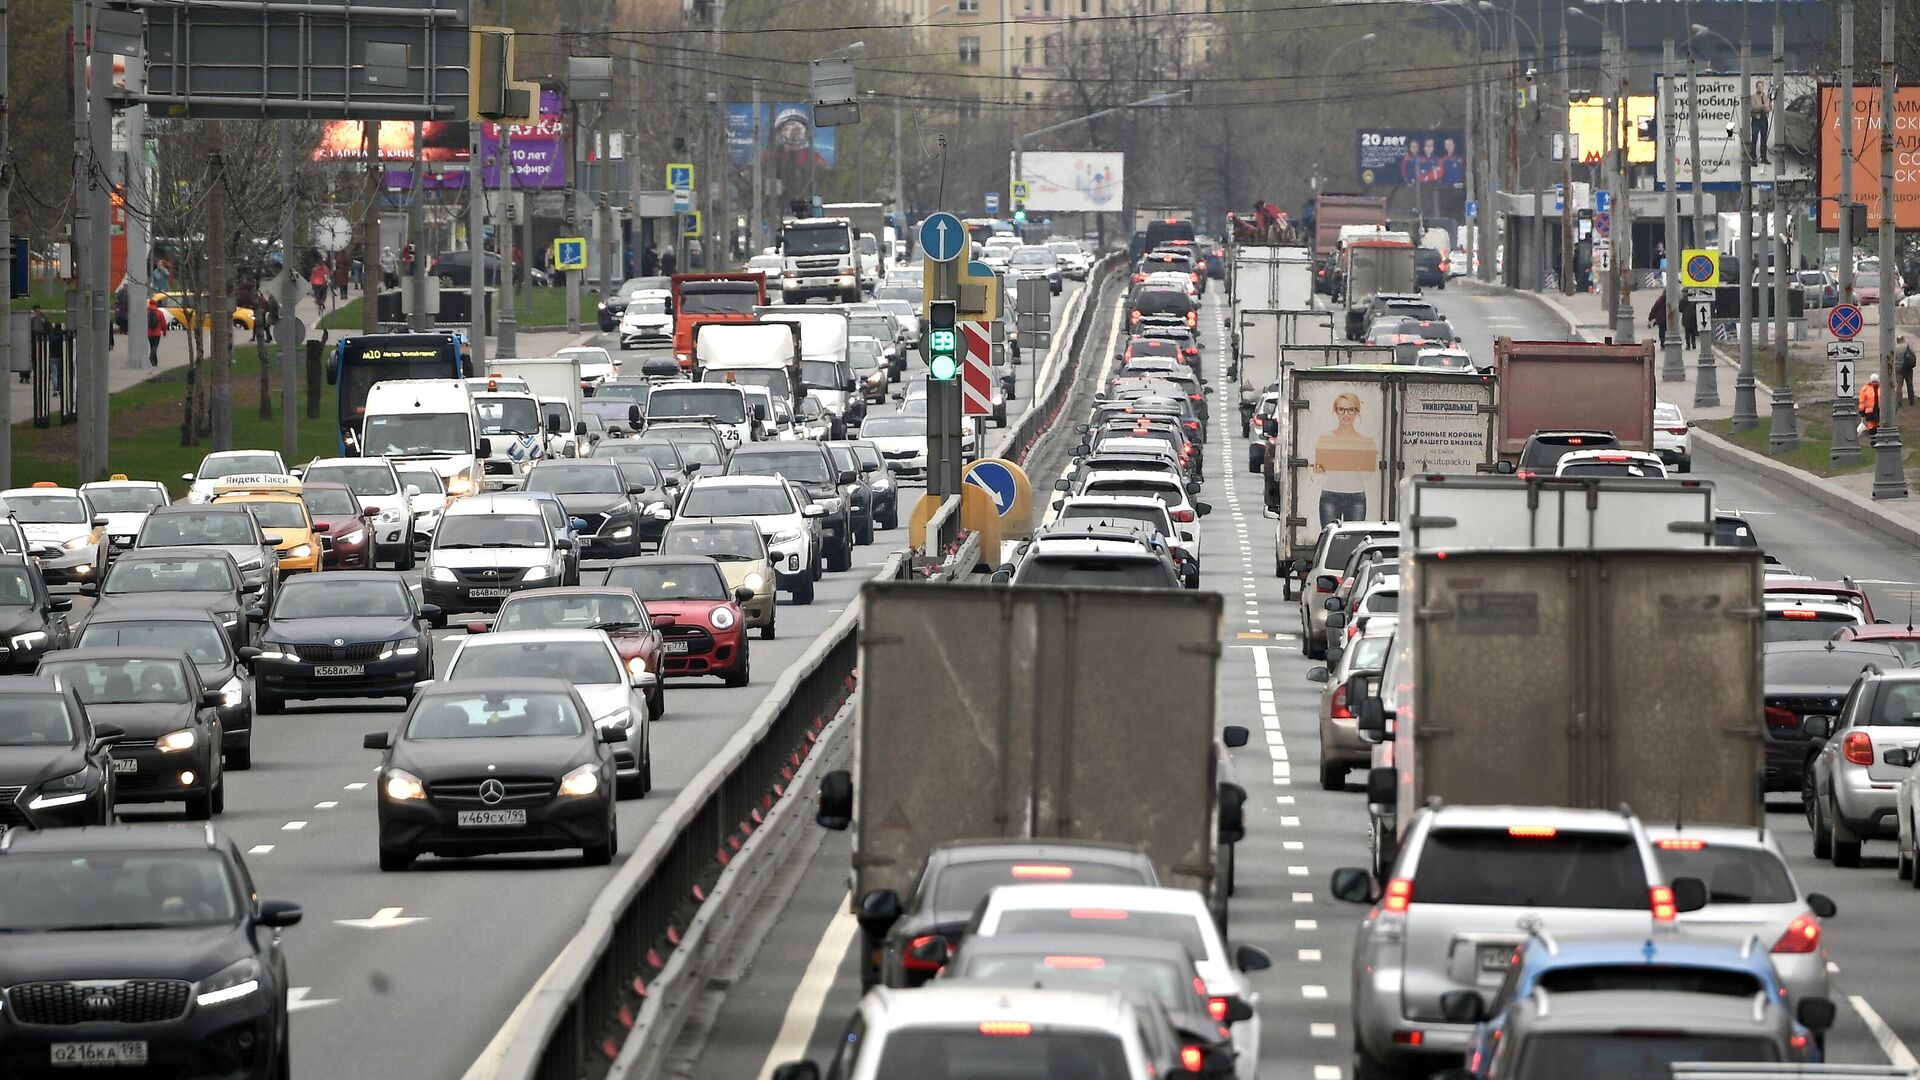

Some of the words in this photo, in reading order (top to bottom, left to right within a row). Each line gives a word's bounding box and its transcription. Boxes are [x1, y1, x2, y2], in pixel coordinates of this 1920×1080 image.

[1674, 82, 1735, 95] ыбрайте
[1833, 117, 1864, 130] АТ
[1361, 133, 1382, 146] 20
[336, 149, 369, 158] АПРЕЛ
[512, 150, 526, 160] 10
[527, 151, 547, 160] лет
[1683, 157, 1731, 168] Аотека
[517, 164, 551, 176] эфире
[1894, 169, 1920, 183] СК
[1402, 430, 1447, 438] КАРТОННЫЕ
[225, 476, 261, 485] Яндекс
[263, 475, 289, 484] Такси
[461, 811, 504, 824] У469СХ
[88, 997, 111, 1008] KIA
[55, 1044, 118, 1061] О216КА
